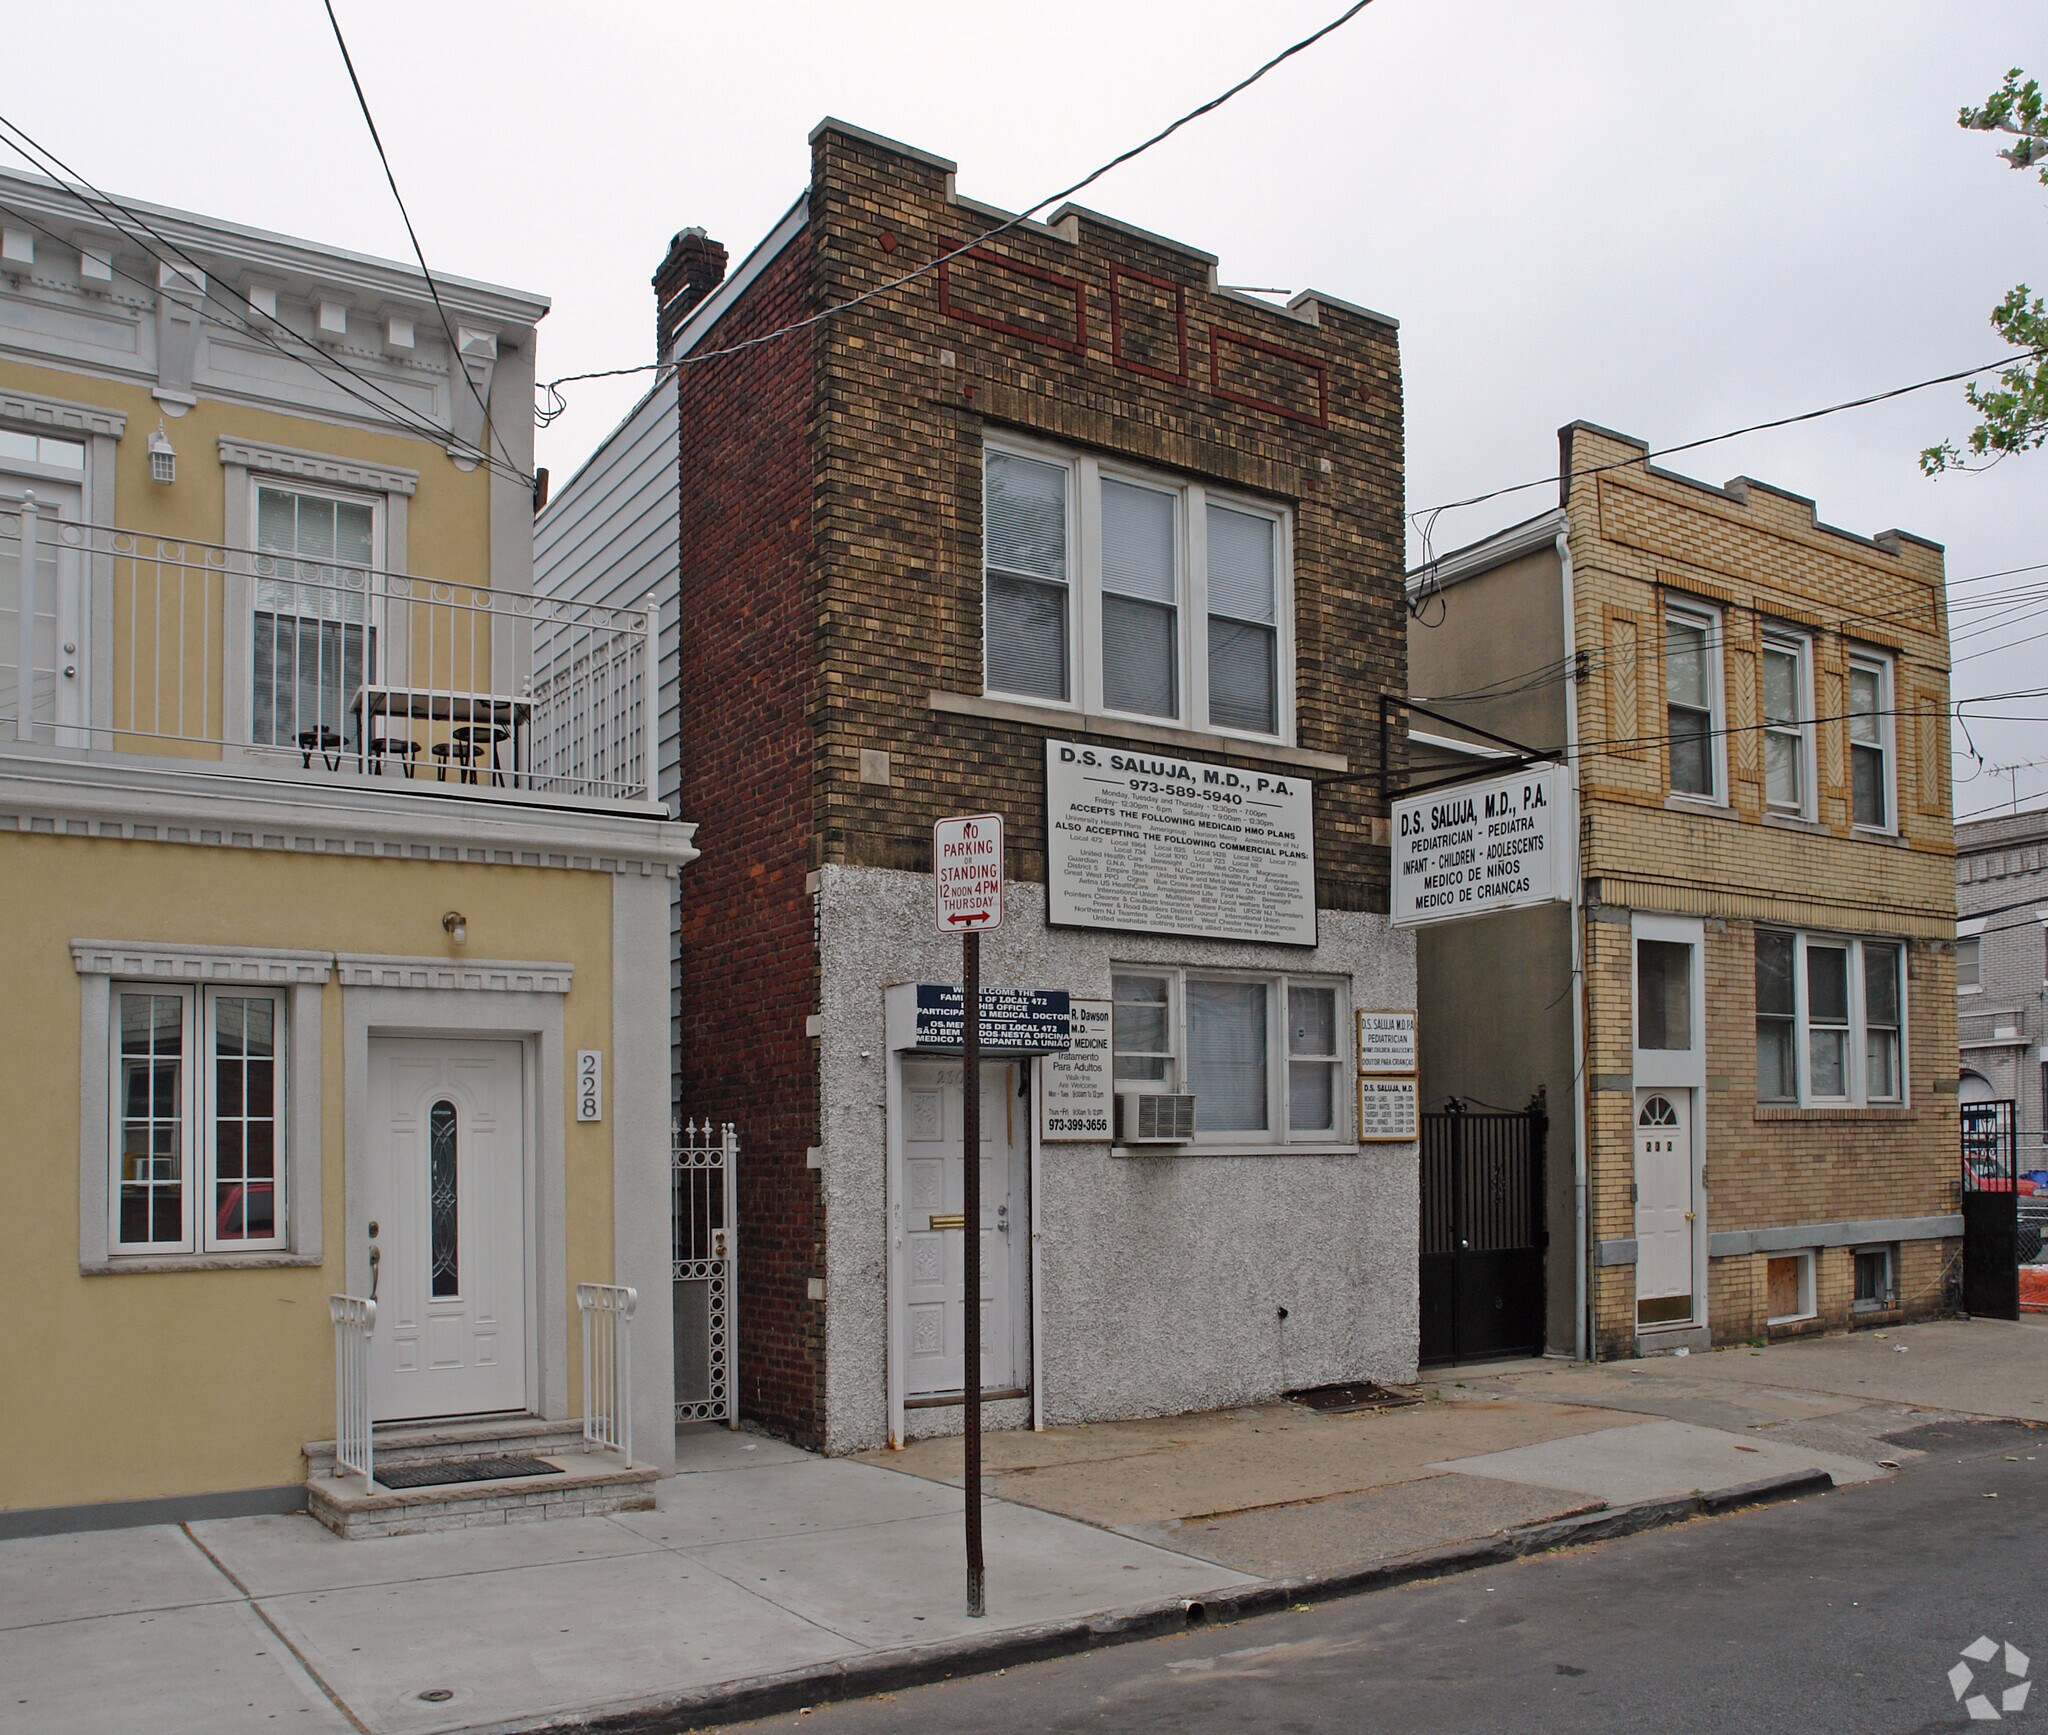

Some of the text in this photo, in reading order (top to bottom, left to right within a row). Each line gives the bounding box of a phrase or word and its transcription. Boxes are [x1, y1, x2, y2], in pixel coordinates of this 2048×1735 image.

[1060, 747, 1294, 796] D.S. SALUJA, M.D., P.A.
[1102, 789, 1129, 799] Monday,
[1132, 793, 1158, 804] Tuesday
[1175, 799, 1204, 810] Thursday
[1129, 779, 1242, 805] 973-589-5940
[1182, 809, 1210, 819] Saturday
[1401, 782, 1546, 837] D.S. SALUJA, M.D., P.A.
[1066, 814, 1098, 825] University
[1101, 819, 1122, 827] Health
[1124, 822, 1141, 830] Plans
[1070, 803, 1295, 839] ACCEPTS THE FOLLOWING MEDICAID HMO PLANS
[963, 825, 978, 839] NO
[1055, 821, 1308, 859] ALSO ACCEPTING THE FOLLOWING COMMERCIAL PLANS:
[1412, 816, 1534, 854] PEDIATRICIAN PEDIATRA
[944, 840, 993, 857] PARKING
[1070, 834, 1088, 842] Local
[1154, 844, 1171, 852] Local
[1114, 846, 1132, 854] Local
[1403, 835, 1543, 876] INFANT CHILDREN ADOLESCENTS
[941, 864, 997, 882] STANDING
[1424, 859, 1520, 890] MEDICO DE NIÑOS
[940, 884, 949, 898] 12
[952, 886, 972, 897] NOON
[984, 880, 998, 894] PM
[944, 896, 993, 910] THURSDAY
[1416, 891, 1453, 910] MEDICO
[1460, 888, 1471, 902] DE
[989, 1011, 1030, 1019] MEDICAL
[1072, 1009, 1108, 1021] R. Dawson
[917, 1026, 937, 1034] SÃO
[1071, 1025, 1088, 1033] M.D.
[1362, 1019, 1394, 1030] D.S. SALUJA
[1041, 1039, 1069, 1047] UNIÃO
[1075, 1039, 1108, 1048] MEDICINE
[1368, 1034, 1407, 1043] PEDIATRICIAN
[1059, 1053, 1099, 1061] Tratamento
[1053, 1062, 1102, 1072] Para Adultos
[583, 1055, 596, 1117] 228
[1049, 1117, 1107, 1132] 973-399-3656
